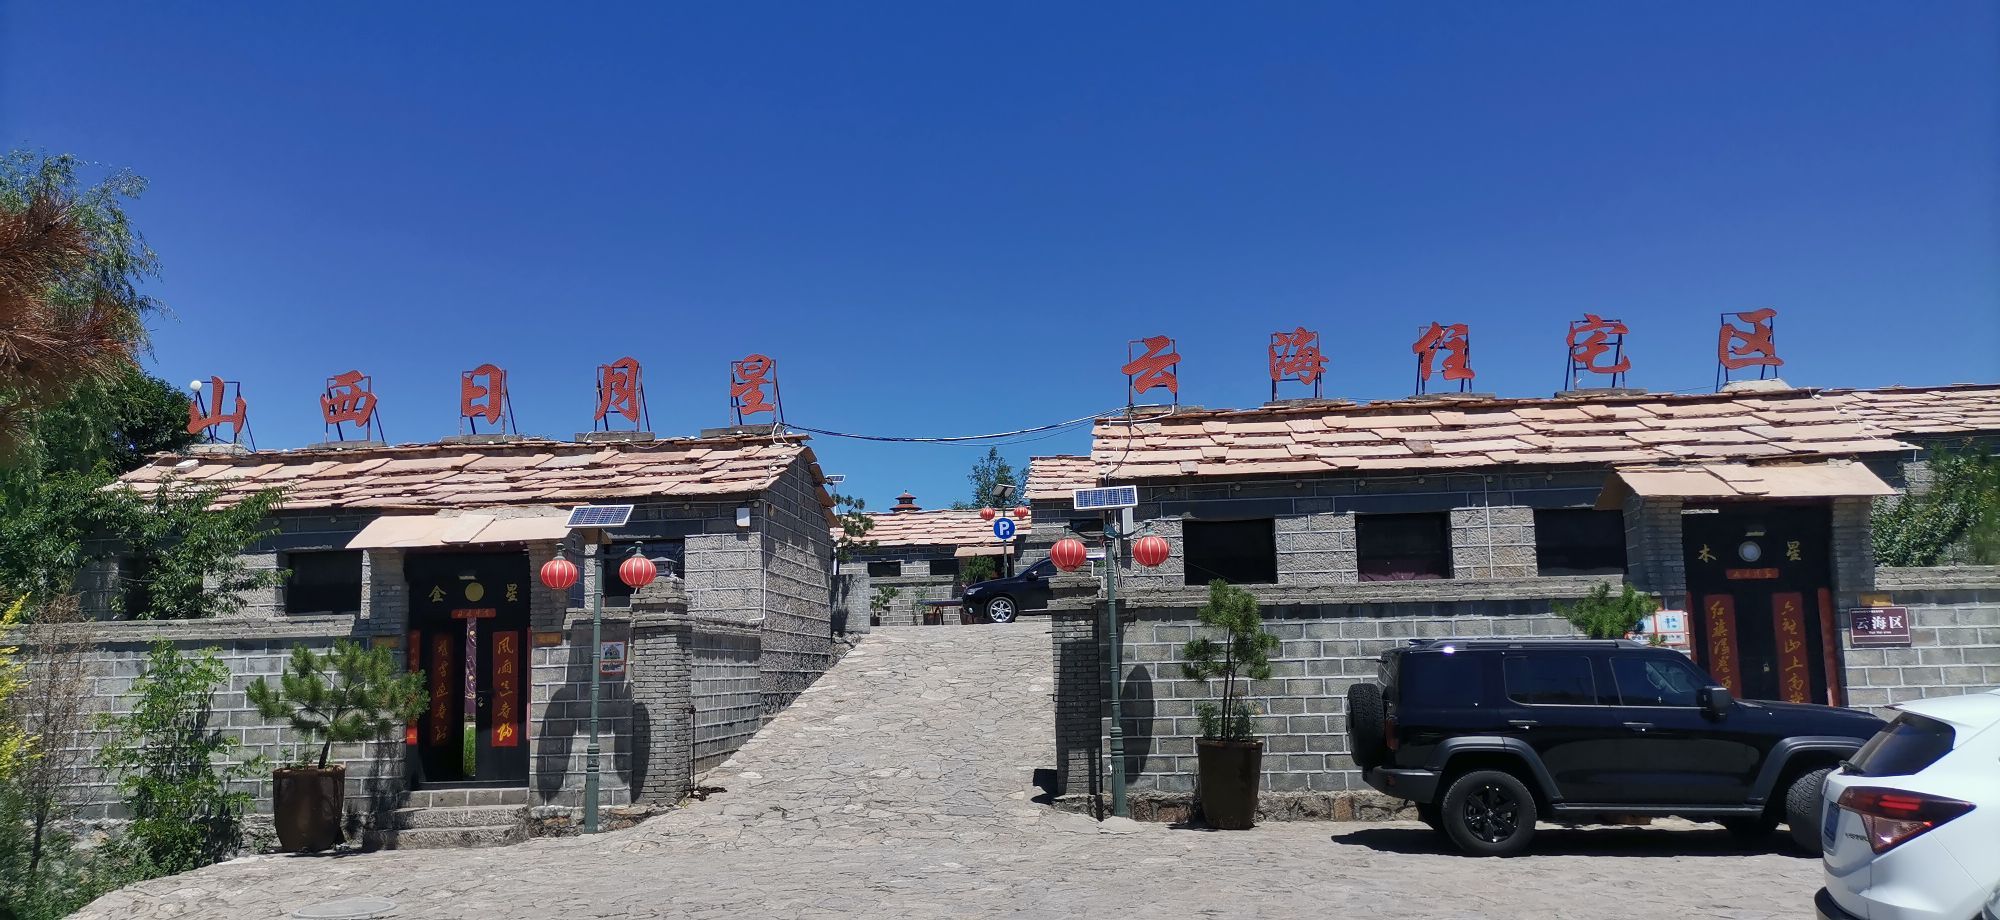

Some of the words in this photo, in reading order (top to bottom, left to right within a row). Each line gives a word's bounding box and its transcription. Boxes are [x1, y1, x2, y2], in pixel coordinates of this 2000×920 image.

[1121, 308, 1783, 394] 云海住宅区
[187, 353, 773, 433] 山西日月星
[999, 521, 1010, 536] P
[1856, 616, 1903, 629] 云海区
